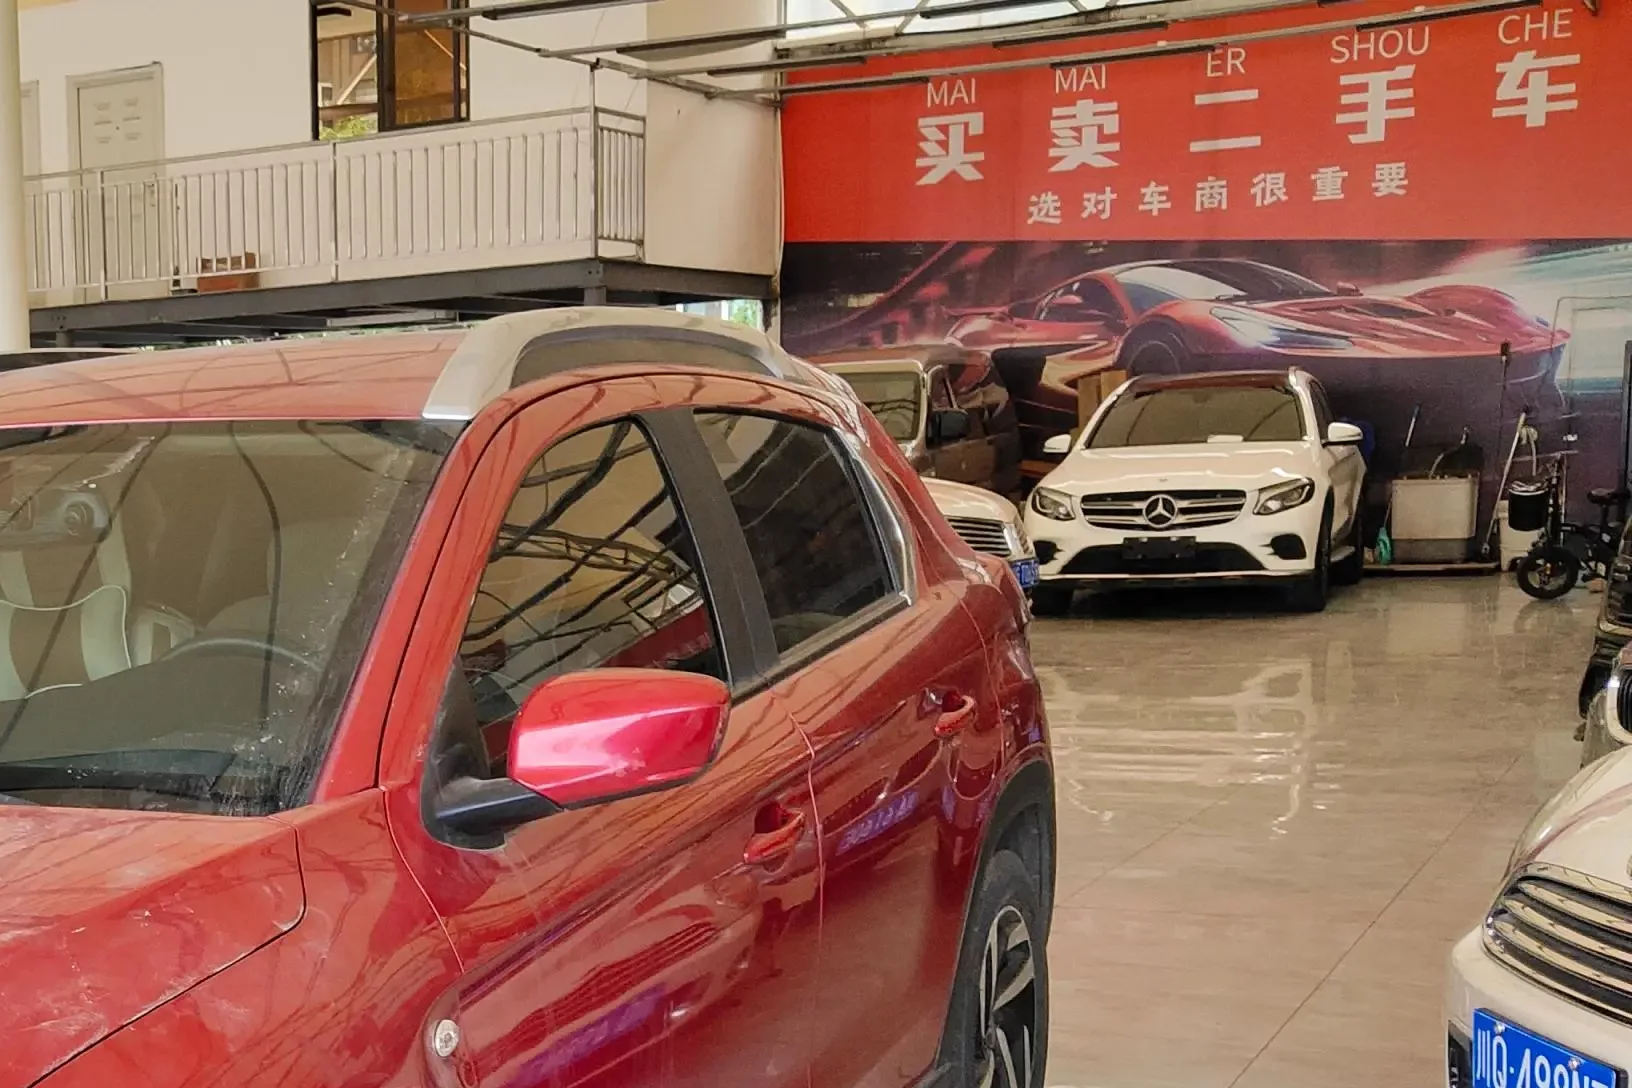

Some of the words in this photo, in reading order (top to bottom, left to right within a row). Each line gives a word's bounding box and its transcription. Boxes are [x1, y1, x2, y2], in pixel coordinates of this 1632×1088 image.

[927, 78, 976, 108] MAI
[1055, 64, 1106, 94] MAI
[1206, 47, 1246, 77] ER
[1330, 26, 1430, 63] SHOU
[1498, 9, 1574, 45] CHE
[915, 50, 1581, 186] 买卖二手车
[1026, 161, 1409, 225] 选对车商很重要
